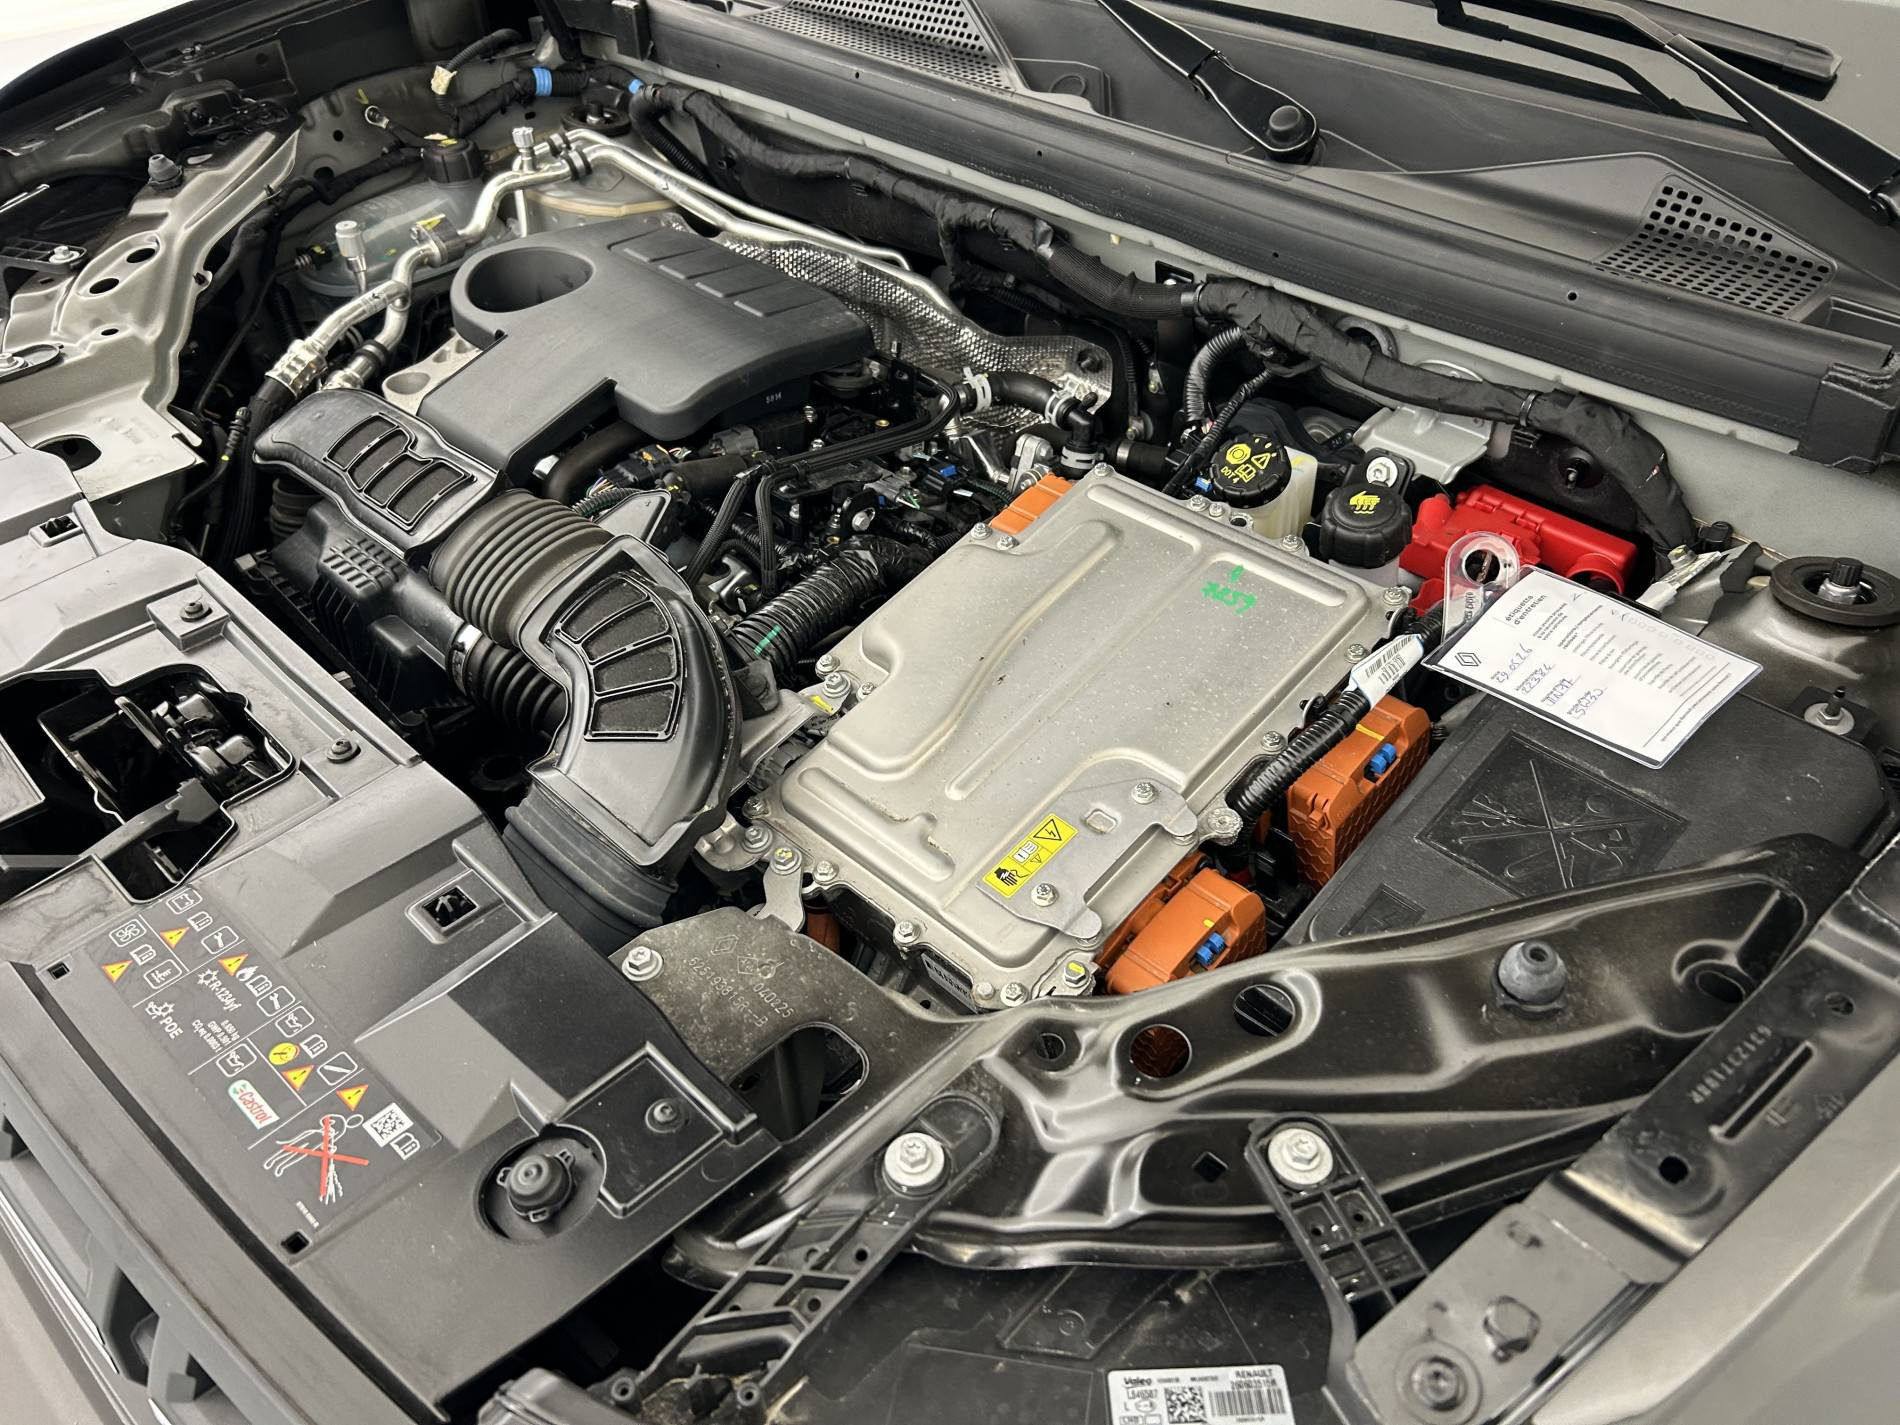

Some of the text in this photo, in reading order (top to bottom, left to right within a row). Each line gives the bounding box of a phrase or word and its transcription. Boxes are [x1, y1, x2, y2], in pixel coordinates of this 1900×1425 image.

[1220, 465, 1235, 478] DOT
[209, 980, 242, 1012] R-1234yf
[160, 1016, 183, 1039] POE
[239, 1091, 273, 1124] Castrol
[1124, 1377, 1152, 1386] Valeo
[1235, 1369, 1273, 1378] RENAULT
